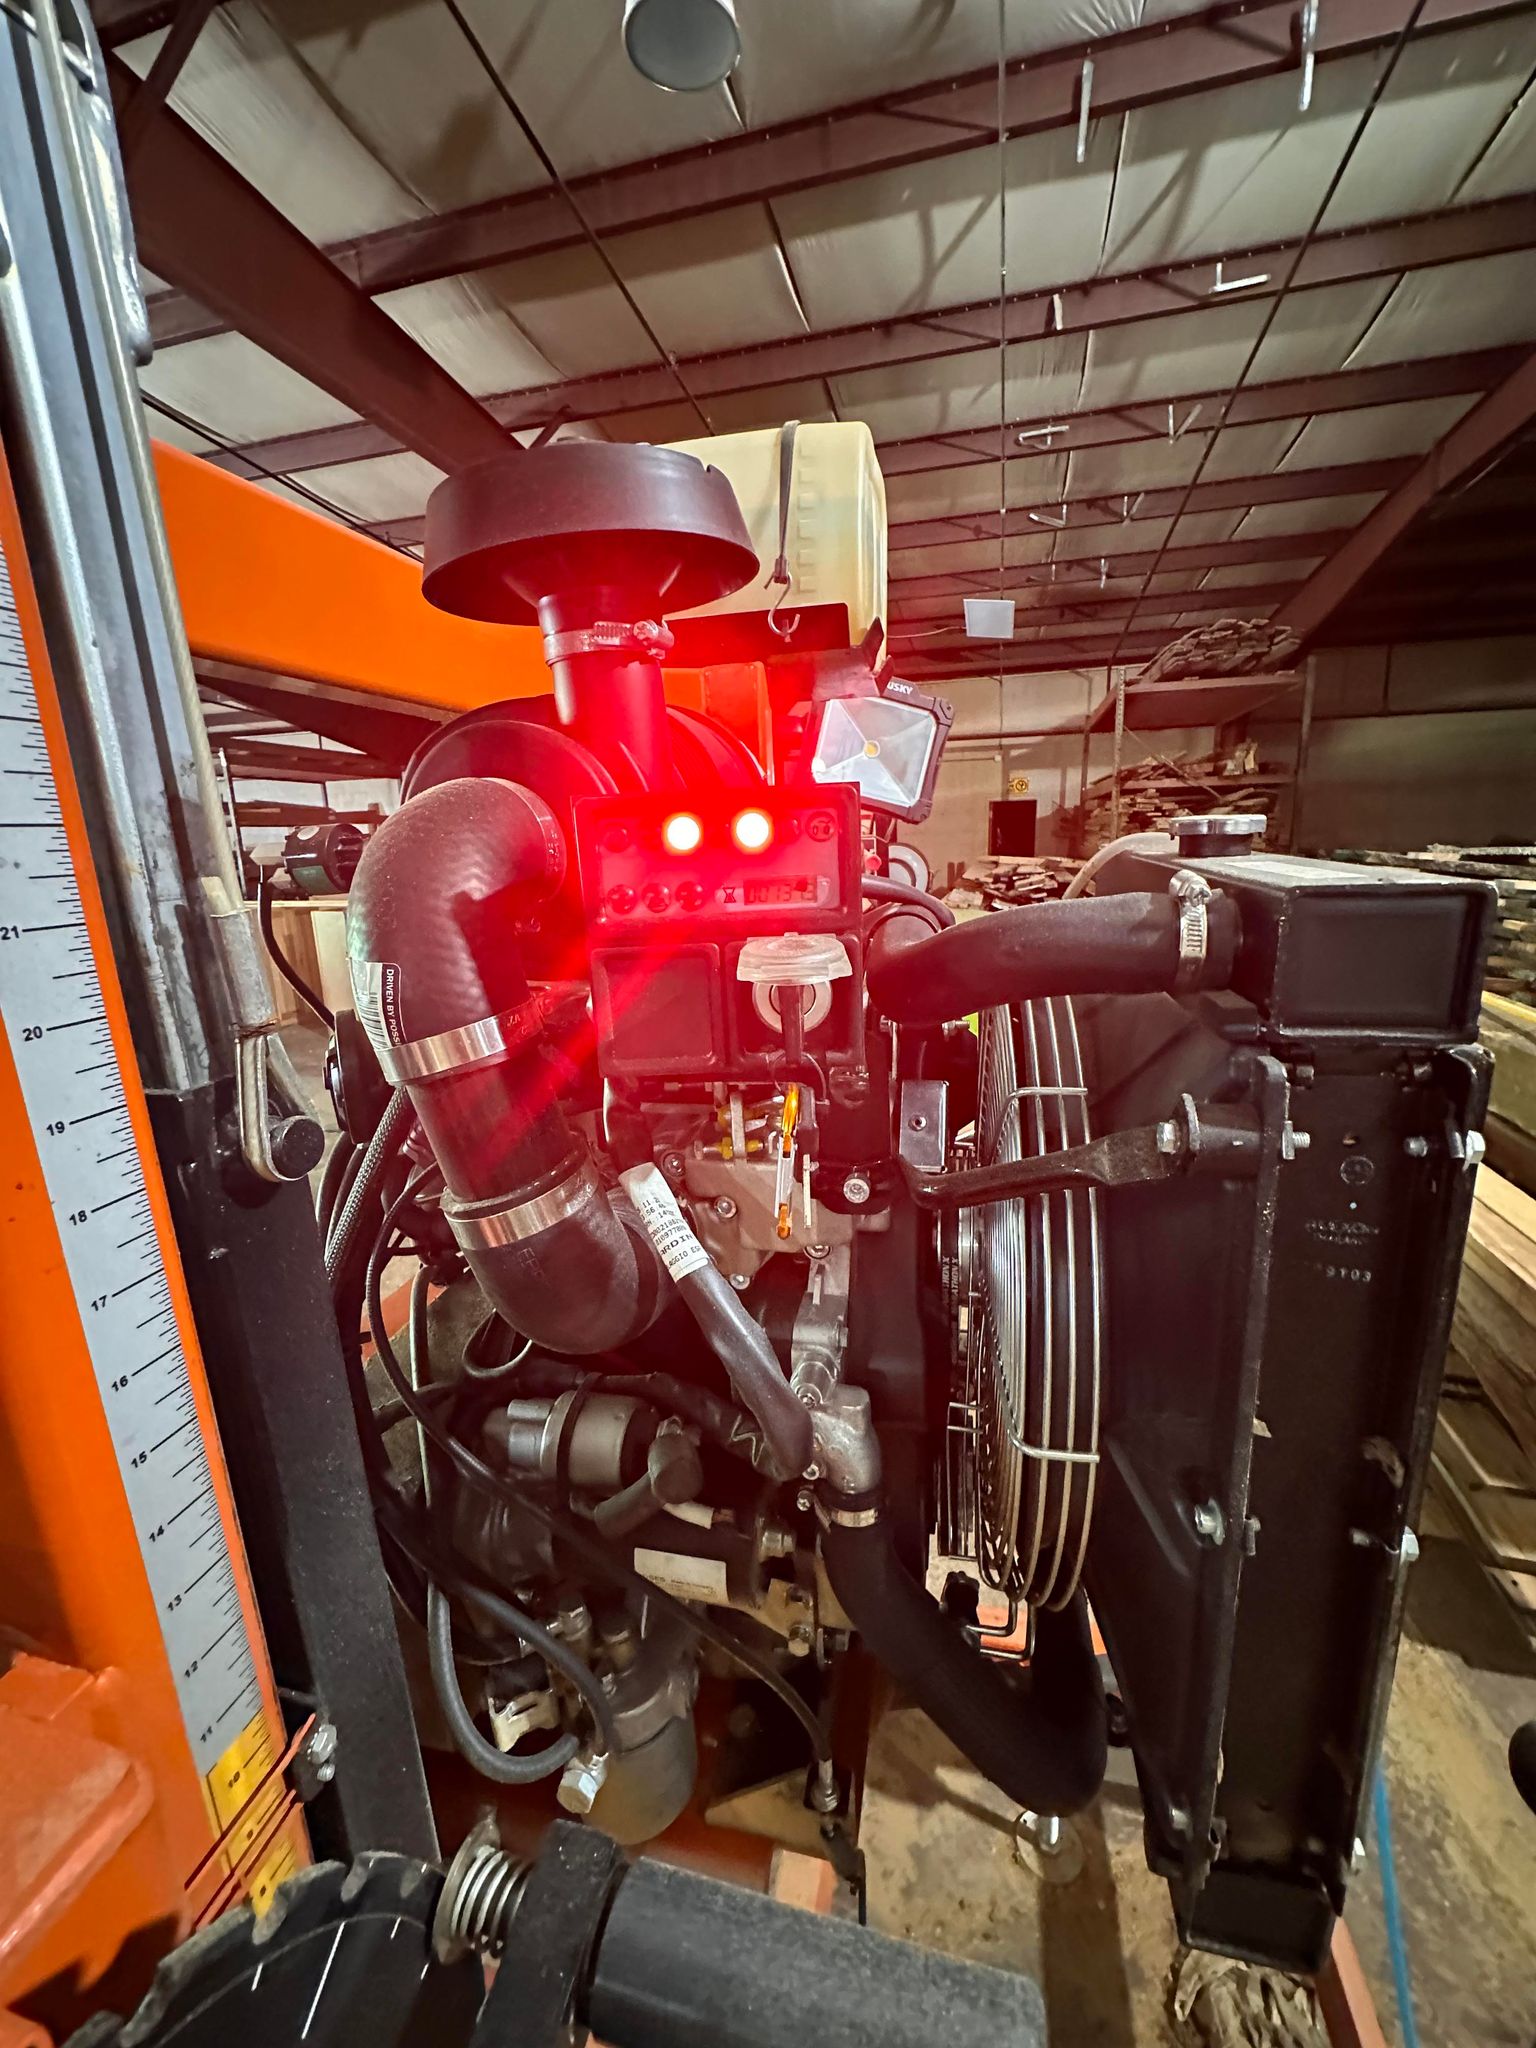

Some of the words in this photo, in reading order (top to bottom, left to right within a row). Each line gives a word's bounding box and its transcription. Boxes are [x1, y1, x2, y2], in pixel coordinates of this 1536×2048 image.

[887, 682, 913, 695] USKY
[0, 925, 19, 940] 21
[386, 969, 394, 1002] DRIVEN
[387, 1006, 395, 1017] BY
[23, 1026, 43, 1041] 20
[46, 1121, 65, 1136] 19
[69, 1210, 87, 1226] 18
[668, 1250, 689, 1269] AGGIO
[91, 1295, 107, 1312] 17
[111, 1375, 128, 1392] 16
[131, 1451, 148, 1469] 15
[149, 1525, 164, 1542] 14
[167, 1594, 182, 1611] 13
[184, 1660, 198, 1678] 12
[200, 1726, 212, 1742] 11
[228, 1771, 240, 1788] 10
